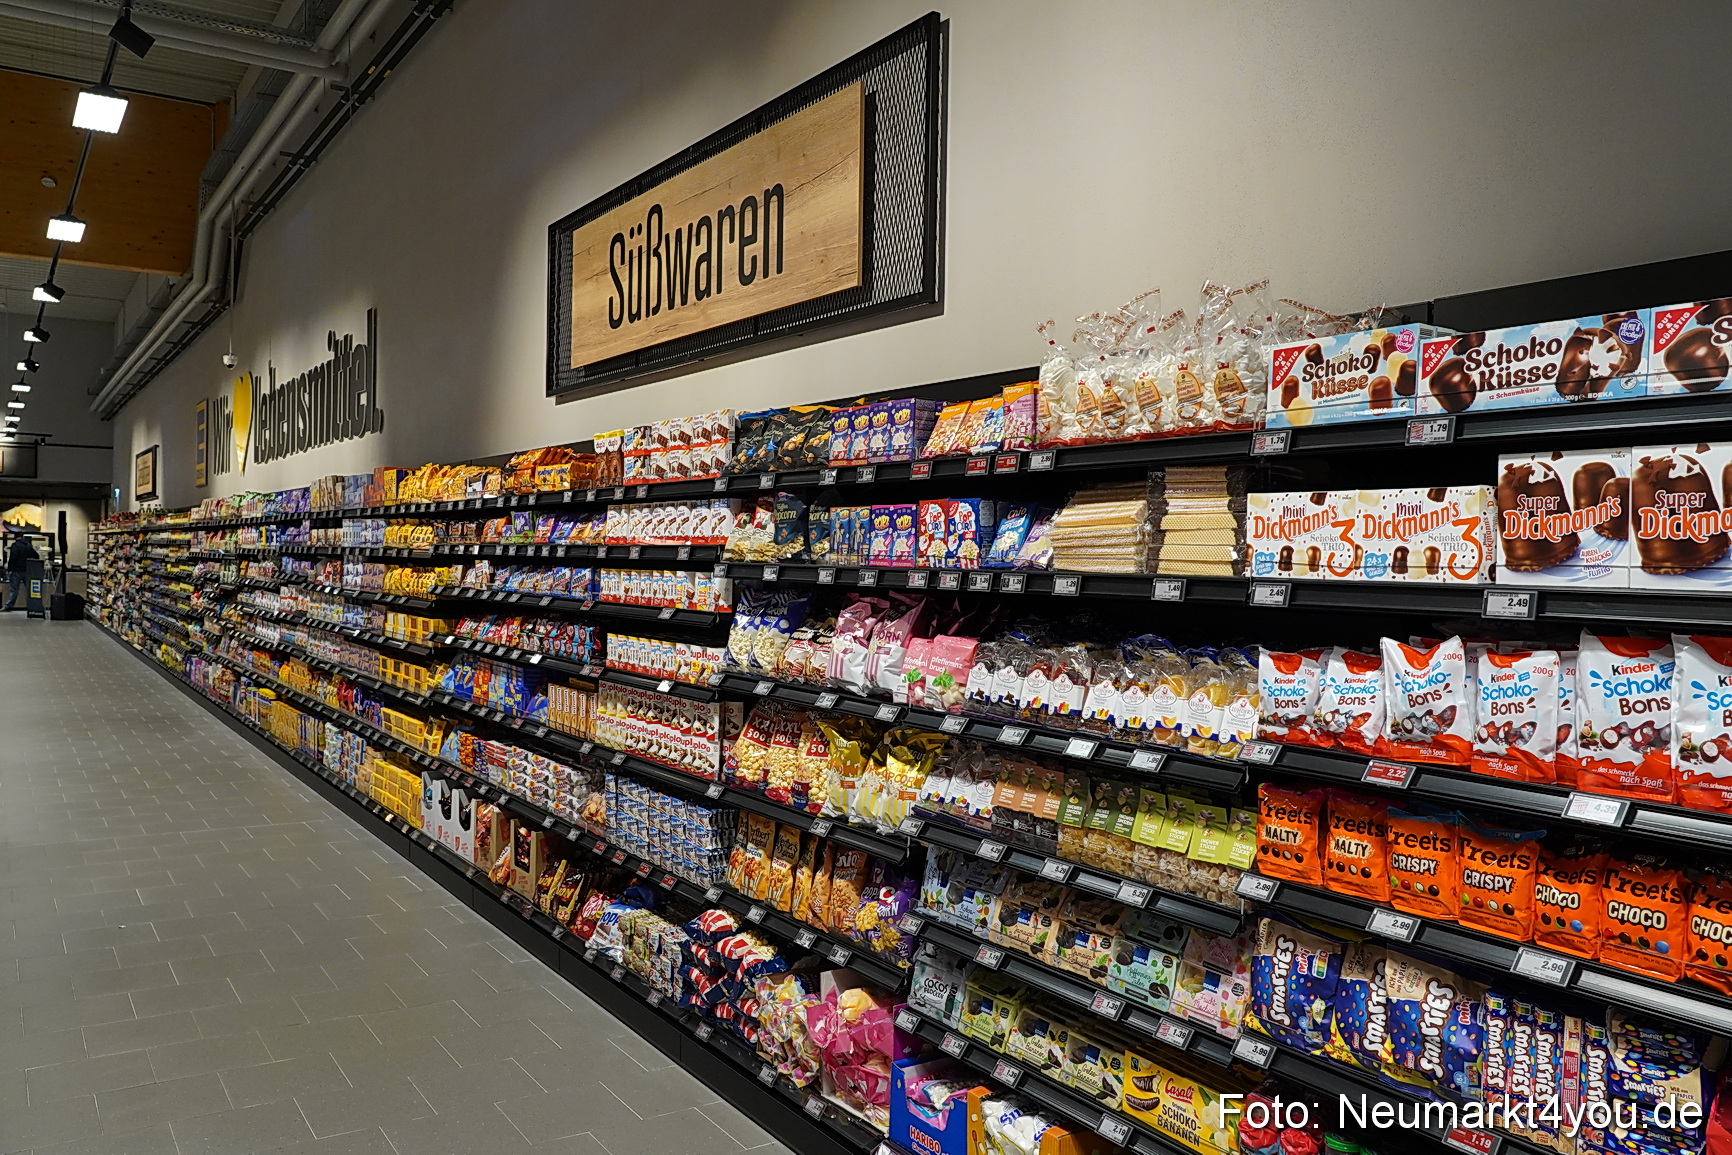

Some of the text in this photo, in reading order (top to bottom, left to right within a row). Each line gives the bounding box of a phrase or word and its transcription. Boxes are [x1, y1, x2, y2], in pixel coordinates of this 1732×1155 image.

[608, 182, 784, 330] Süßwaren
[1657, 313, 1672, 329] GUT
[1659, 312, 1690, 345] GÜNSTIG
[1275, 350, 1287, 367] GUT
[1424, 345, 1436, 359] GUT
[1425, 343, 1449, 372] GÜNSTIG
[1464, 335, 1563, 371] Schoko
[1276, 351, 1299, 382] GÜNSTIG
[1302, 353, 1374, 383] Schoko
[1478, 361, 1557, 391] Küsse
[1311, 375, 1369, 400] Küsse
[1496, 387, 1540, 399] Schaumküsse
[1429, 423, 1447, 433] 1.79
[1270, 436, 1285, 445] 1.79
[1396, 501, 1423, 517] mini
[1518, 494, 1560, 516] Super
[1655, 490, 1706, 512] Super
[929, 511, 942, 522] POP
[958, 511, 972, 522] POP
[1282, 504, 1306, 519] mini
[1253, 504, 1338, 543] Dickmann's
[1362, 500, 1460, 542] Dickmann's
[1503, 497, 1621, 543] Dickmann's
[1310, 534, 1339, 543] Schoko
[1427, 532, 1461, 543] Schoko
[1322, 543, 1345, 552] TRIO
[1327, 517, 1355, 577] 3
[1441, 543, 1468, 552] TRIO
[1447, 517, 1482, 580] 3
[1269, 589, 1284, 597] 2.49
[1508, 598, 1528, 607] 2.49
[1442, 652, 1463, 662] 200g
[1532, 666, 1553, 677] 200g
[1267, 686, 1309, 698] Schoko-
[1408, 689, 1442, 708] Bons
[1481, 681, 1539, 702] Schoko-
[1274, 697, 1299, 709] Bons
[1337, 696, 1367, 706] Bons
[1490, 701, 1524, 716] Bons
[1618, 697, 1671, 716] Bons
[1257, 746, 1273, 756] 2.19
[1386, 768, 1407, 778] 2.22
[1620, 775, 1663, 788] nach Spaß
[1593, 803, 1618, 815] 4.39
[1264, 825, 1299, 845] MALTY
[1334, 838, 1369, 858] MALTY
[1459, 836, 1531, 871] Treets
[1054, 865, 1066, 875] 5.29
[1392, 853, 1438, 875] CRISPY
[1255, 881, 1271, 892] 2.99
[1463, 868, 1514, 893] CRISPY
[1602, 868, 1682, 904] Treets
[1132, 889, 1146, 899] 5.29
[1535, 884, 1580, 909] CHOCO
[1608, 900, 1667, 930] CHOCO
[1392, 919, 1411, 931] 2.99
[1295, 948, 1311, 974] mini
[1541, 960, 1564, 974] 2.99
[923, 978, 948, 994] COCOS
[1106, 1001, 1118, 1011] 1.39
[1456, 996, 1473, 1025] mini
[1172, 1028, 1187, 1040] 1.39
[1252, 1045, 1268, 1057] 3.99
[1165, 1077, 1195, 1100] Casali
[1162, 1104, 1202, 1131] SCHOKO-
[1113, 1125, 1126, 1136] 2.19
[1157, 1114, 1200, 1147] BANANEN
[909, 1125, 941, 1154] HARIBO
[1470, 1132, 1492, 1149] 1.19
